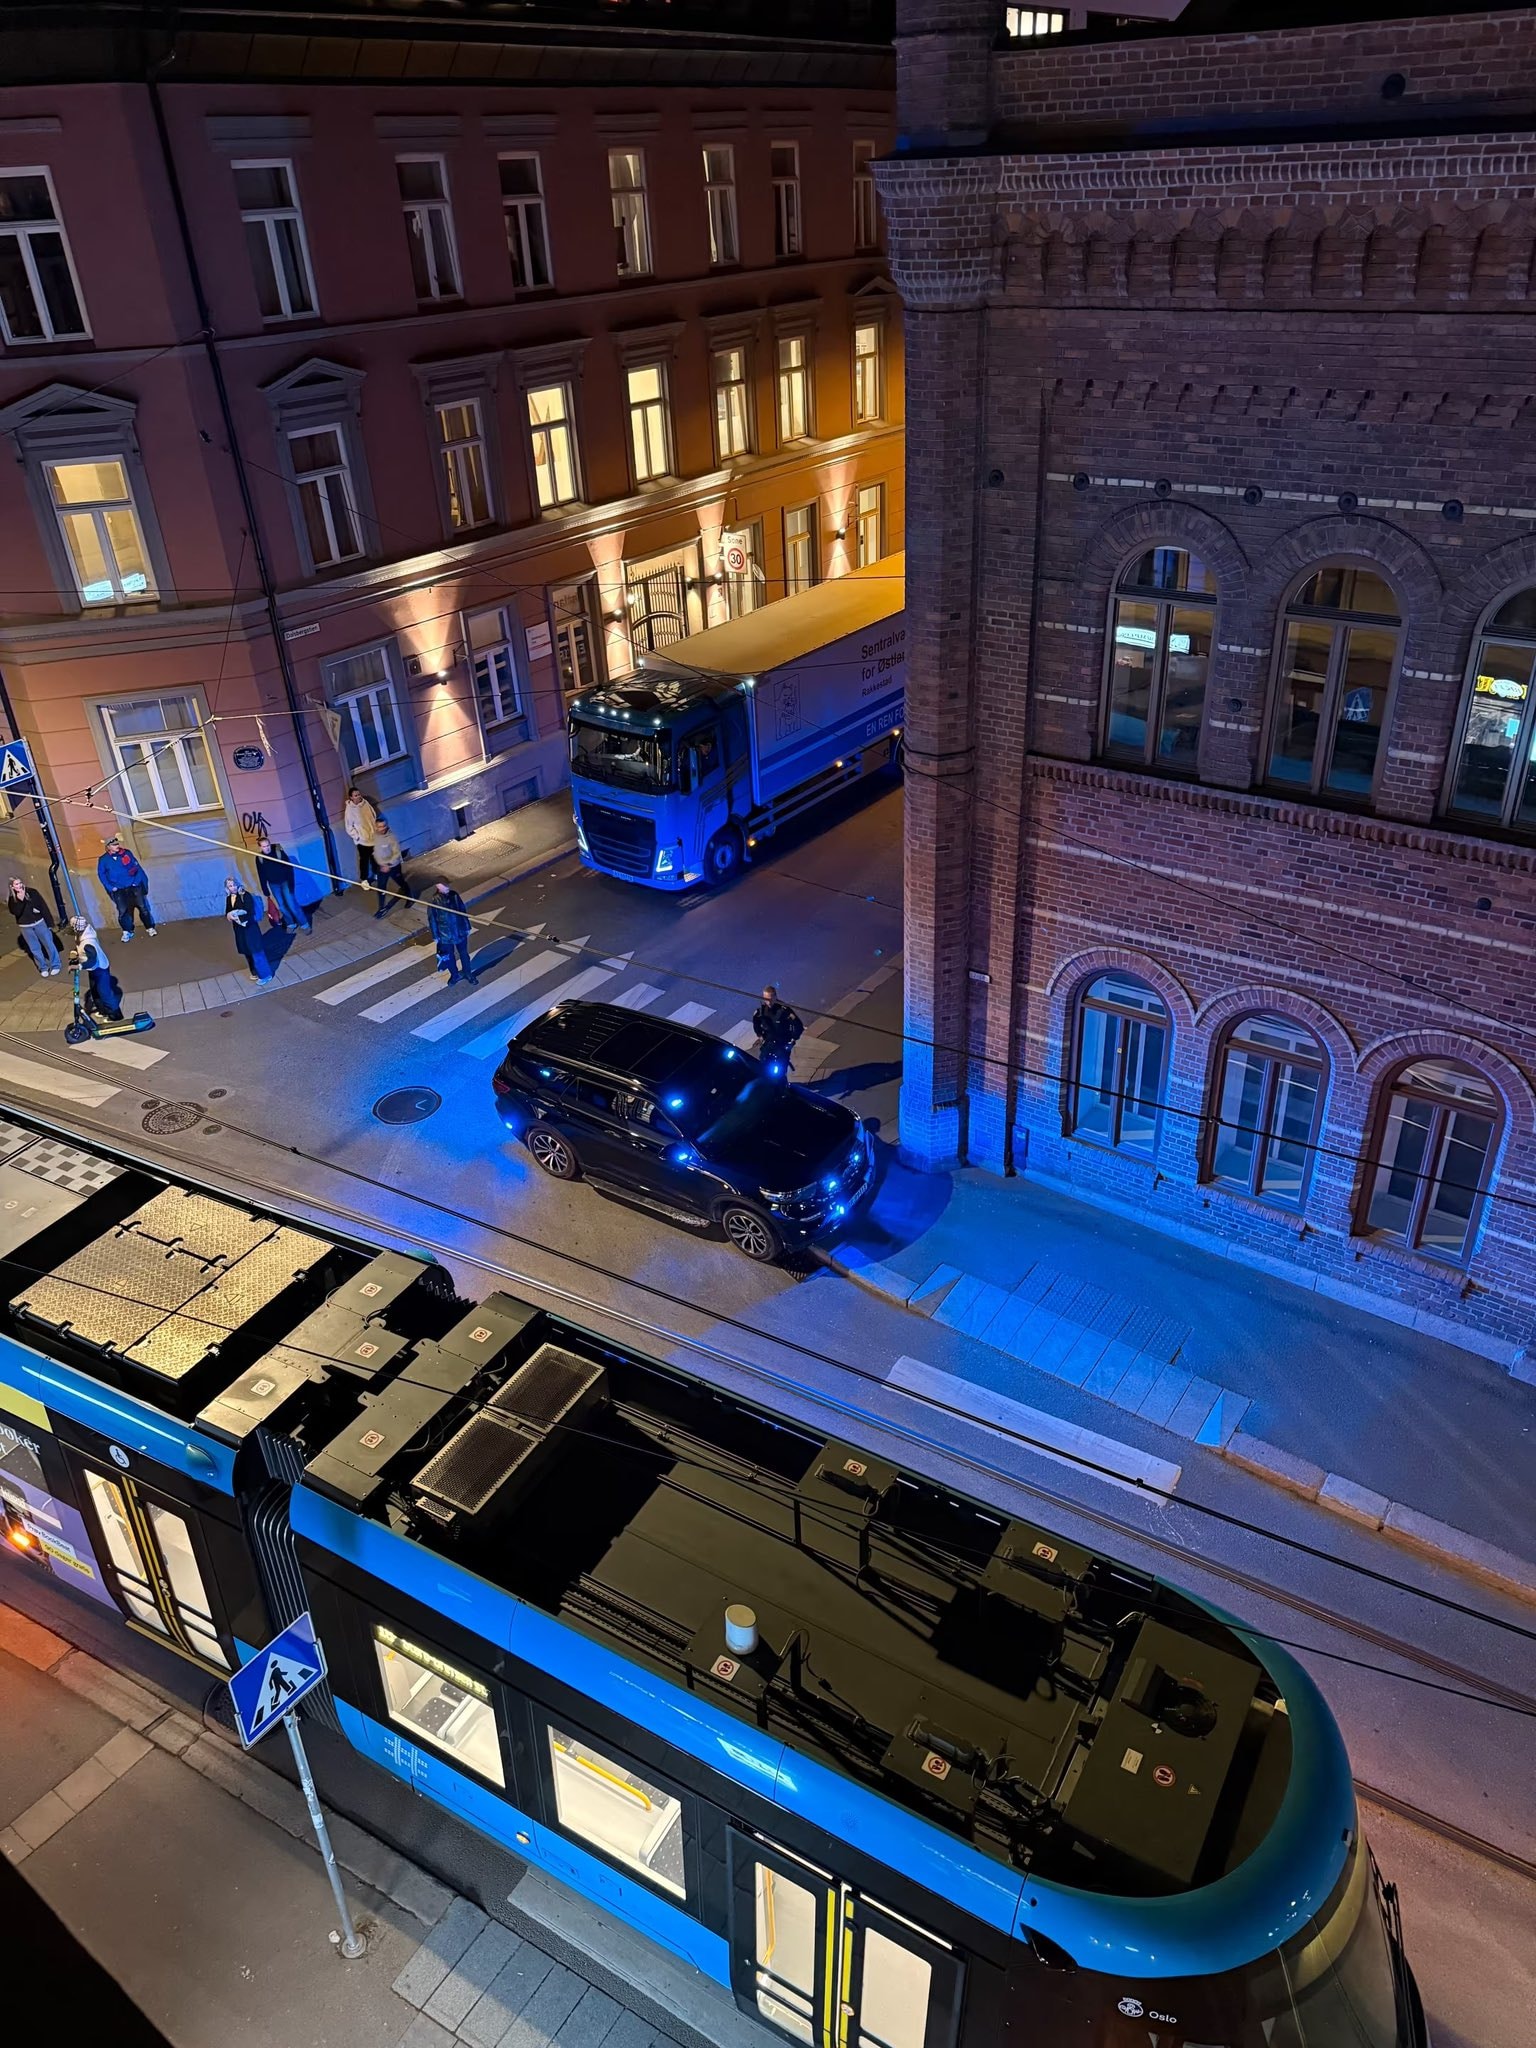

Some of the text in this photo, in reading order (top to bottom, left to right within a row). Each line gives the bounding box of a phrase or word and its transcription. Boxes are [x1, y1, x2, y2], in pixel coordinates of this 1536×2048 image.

[728, 536, 743, 545] Sone
[731, 553, 742, 565] 30
[862, 667, 875, 681] for
[866, 720, 877, 737] EN
[878, 711, 894, 730] REN
[1149, 2011, 1177, 2024] Oslo
